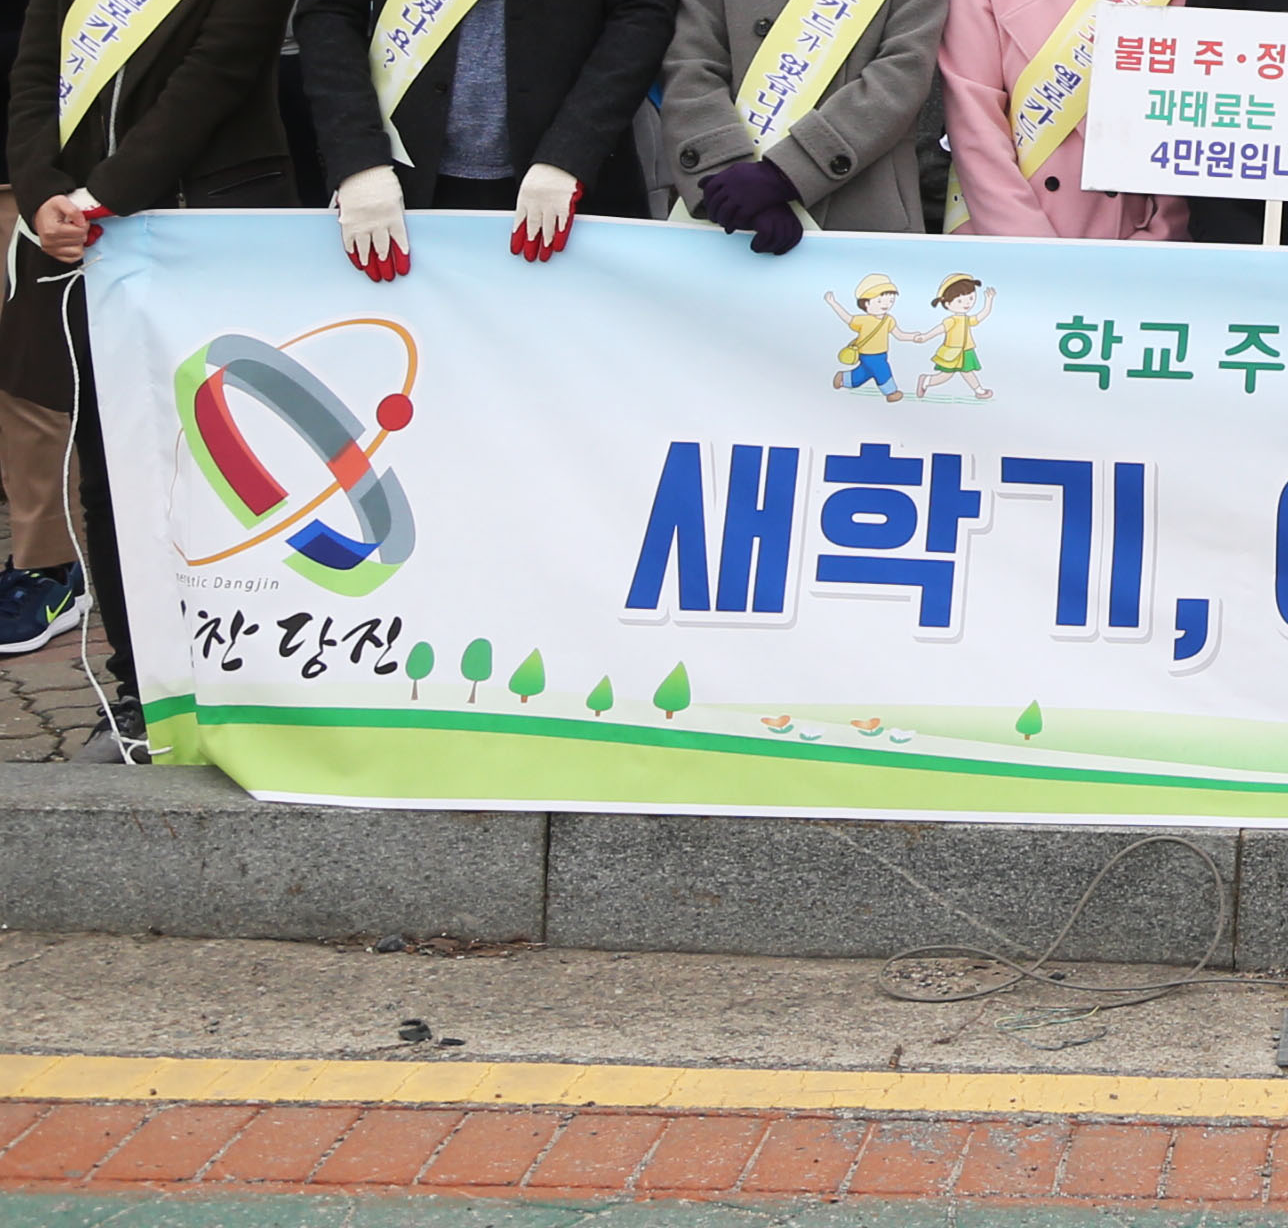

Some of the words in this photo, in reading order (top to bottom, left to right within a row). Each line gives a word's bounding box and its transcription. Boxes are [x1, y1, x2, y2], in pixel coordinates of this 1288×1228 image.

[1113, 35, 1179, 75] 불법
[1144, 88, 1277, 131] 과태료는
[1055, 314, 1194, 391] 학교
[624, 440, 1211, 662] 새학기,
[213, 576, 280, 593] Dangjin
[276, 611, 403, 680] 당진
